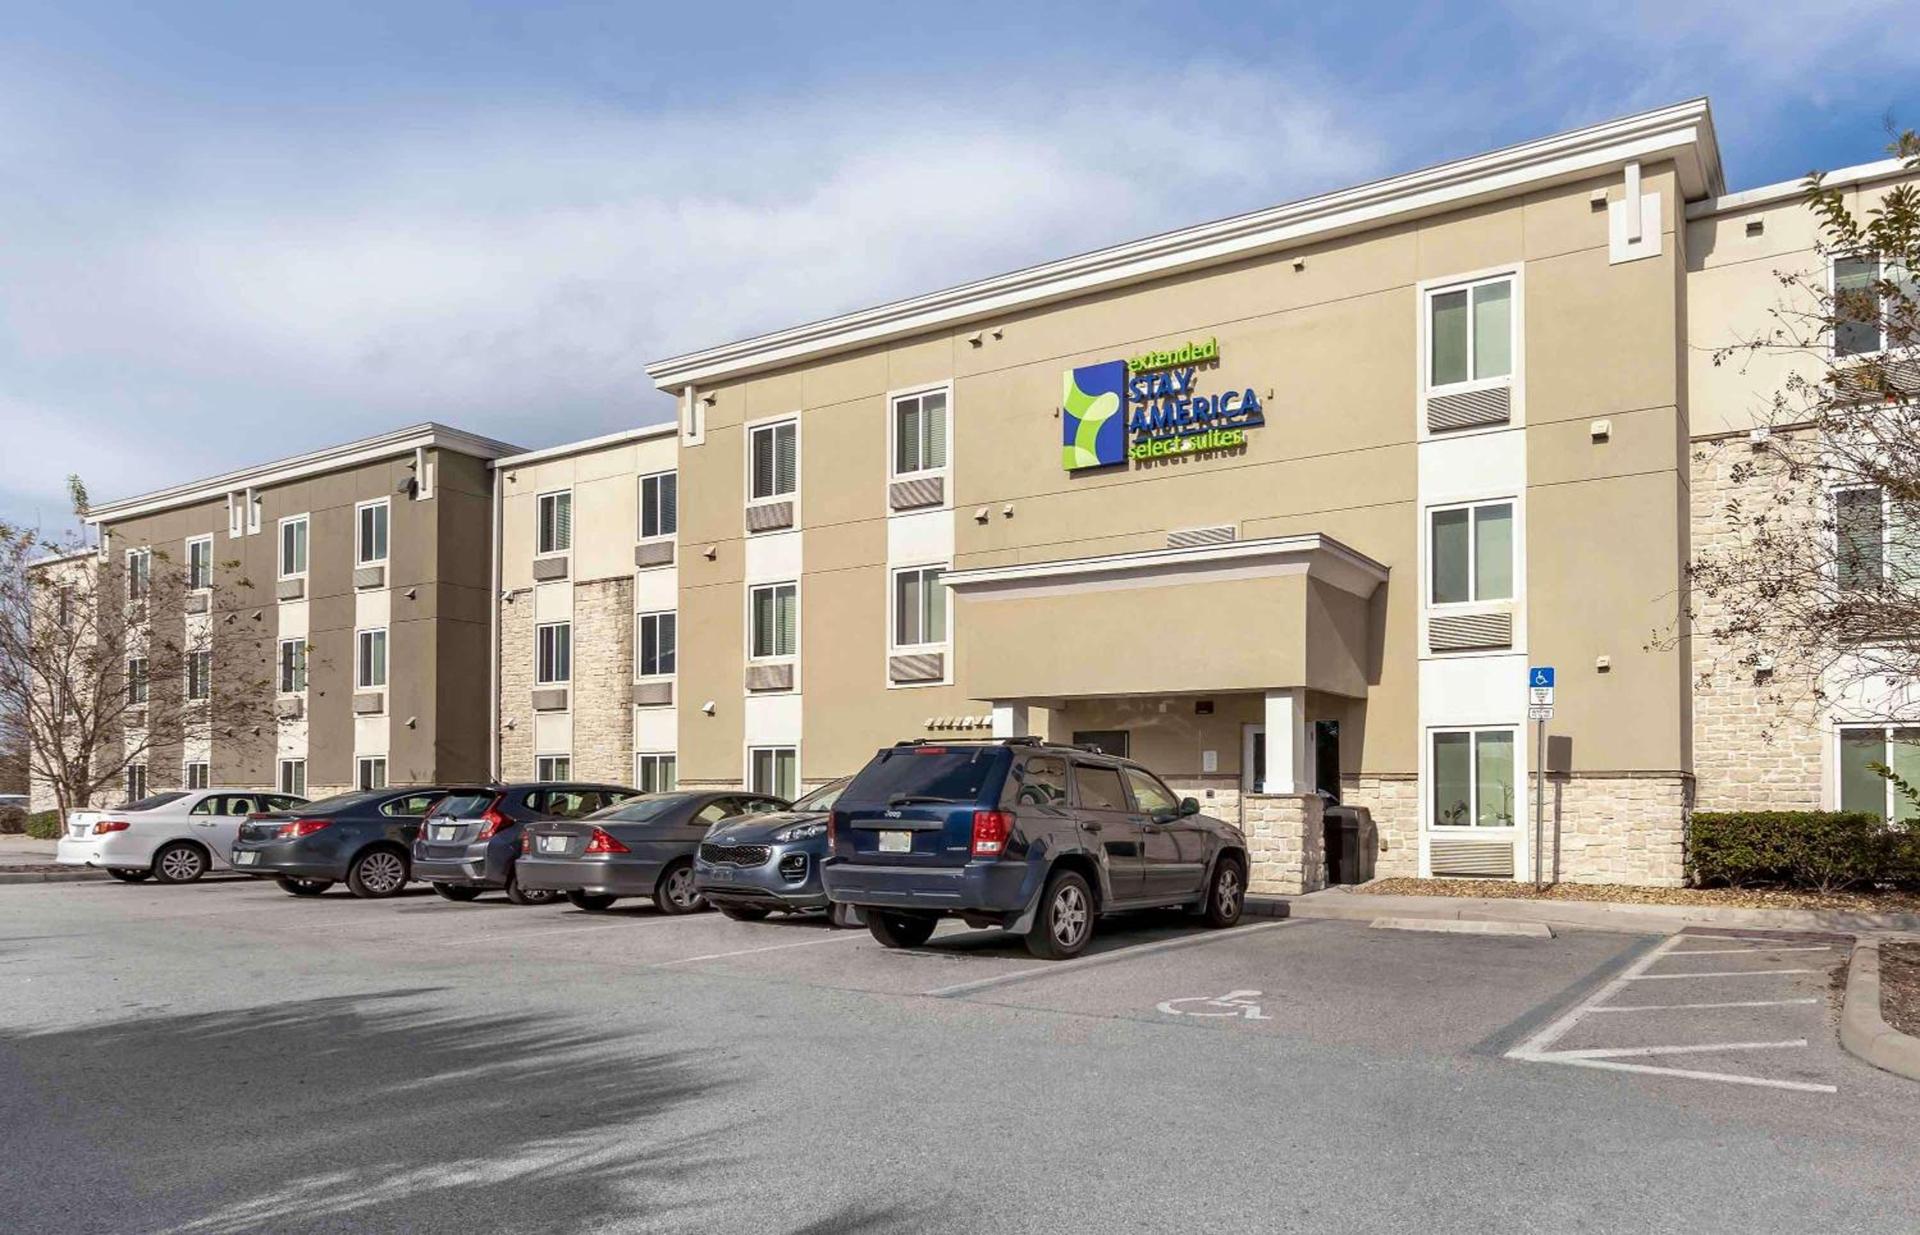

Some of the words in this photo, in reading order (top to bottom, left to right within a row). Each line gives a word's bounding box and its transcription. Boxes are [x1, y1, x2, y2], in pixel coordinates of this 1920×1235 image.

[1128, 337, 1217, 373] extended
[1129, 366, 1194, 403] STAY
[1129, 388, 1260, 433] AMERICA
[1129, 434, 1182, 459] select
[1189, 428, 1245, 452] suites
[884, 809, 902, 819] Jeep
